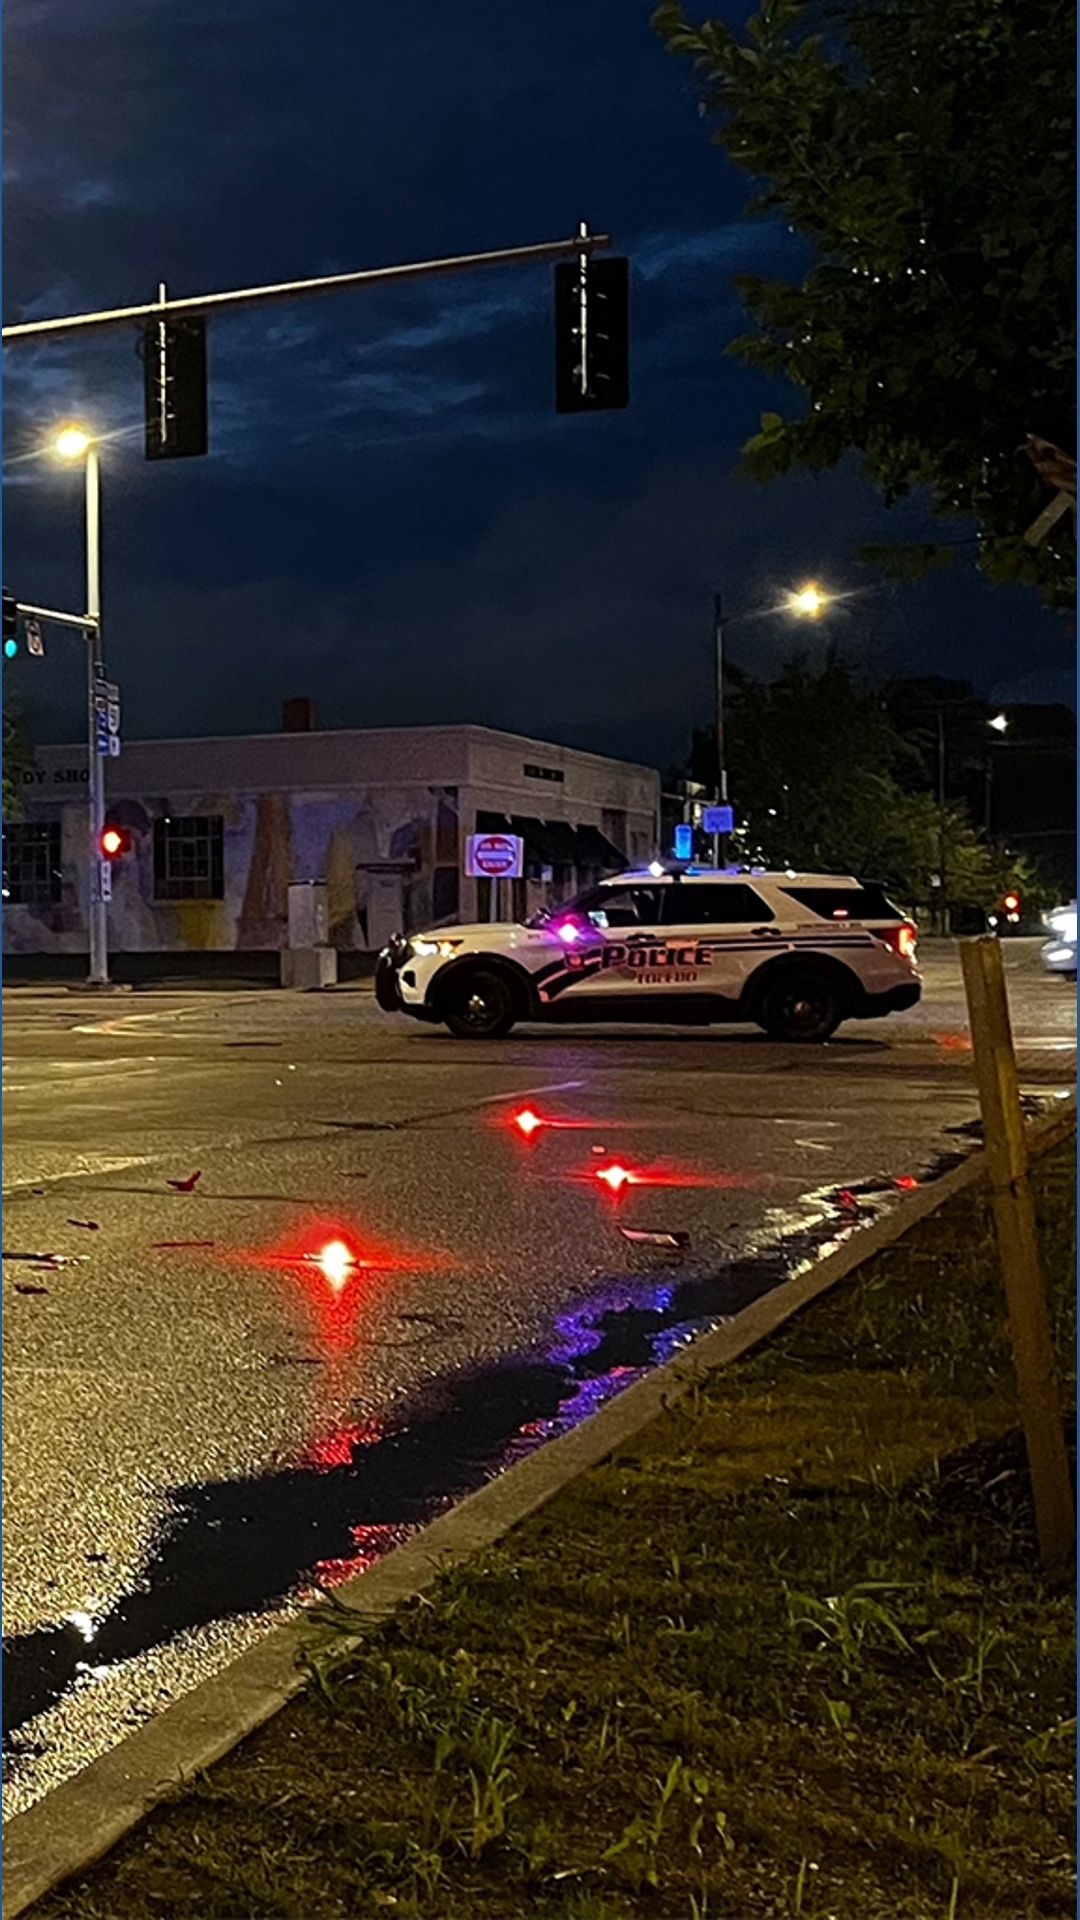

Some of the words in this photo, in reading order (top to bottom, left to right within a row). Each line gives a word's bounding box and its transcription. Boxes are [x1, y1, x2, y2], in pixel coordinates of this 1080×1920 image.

[22, 771, 46, 785] DY
[53, 769, 90, 784] SHO
[602, 945, 713, 968] POLICE
